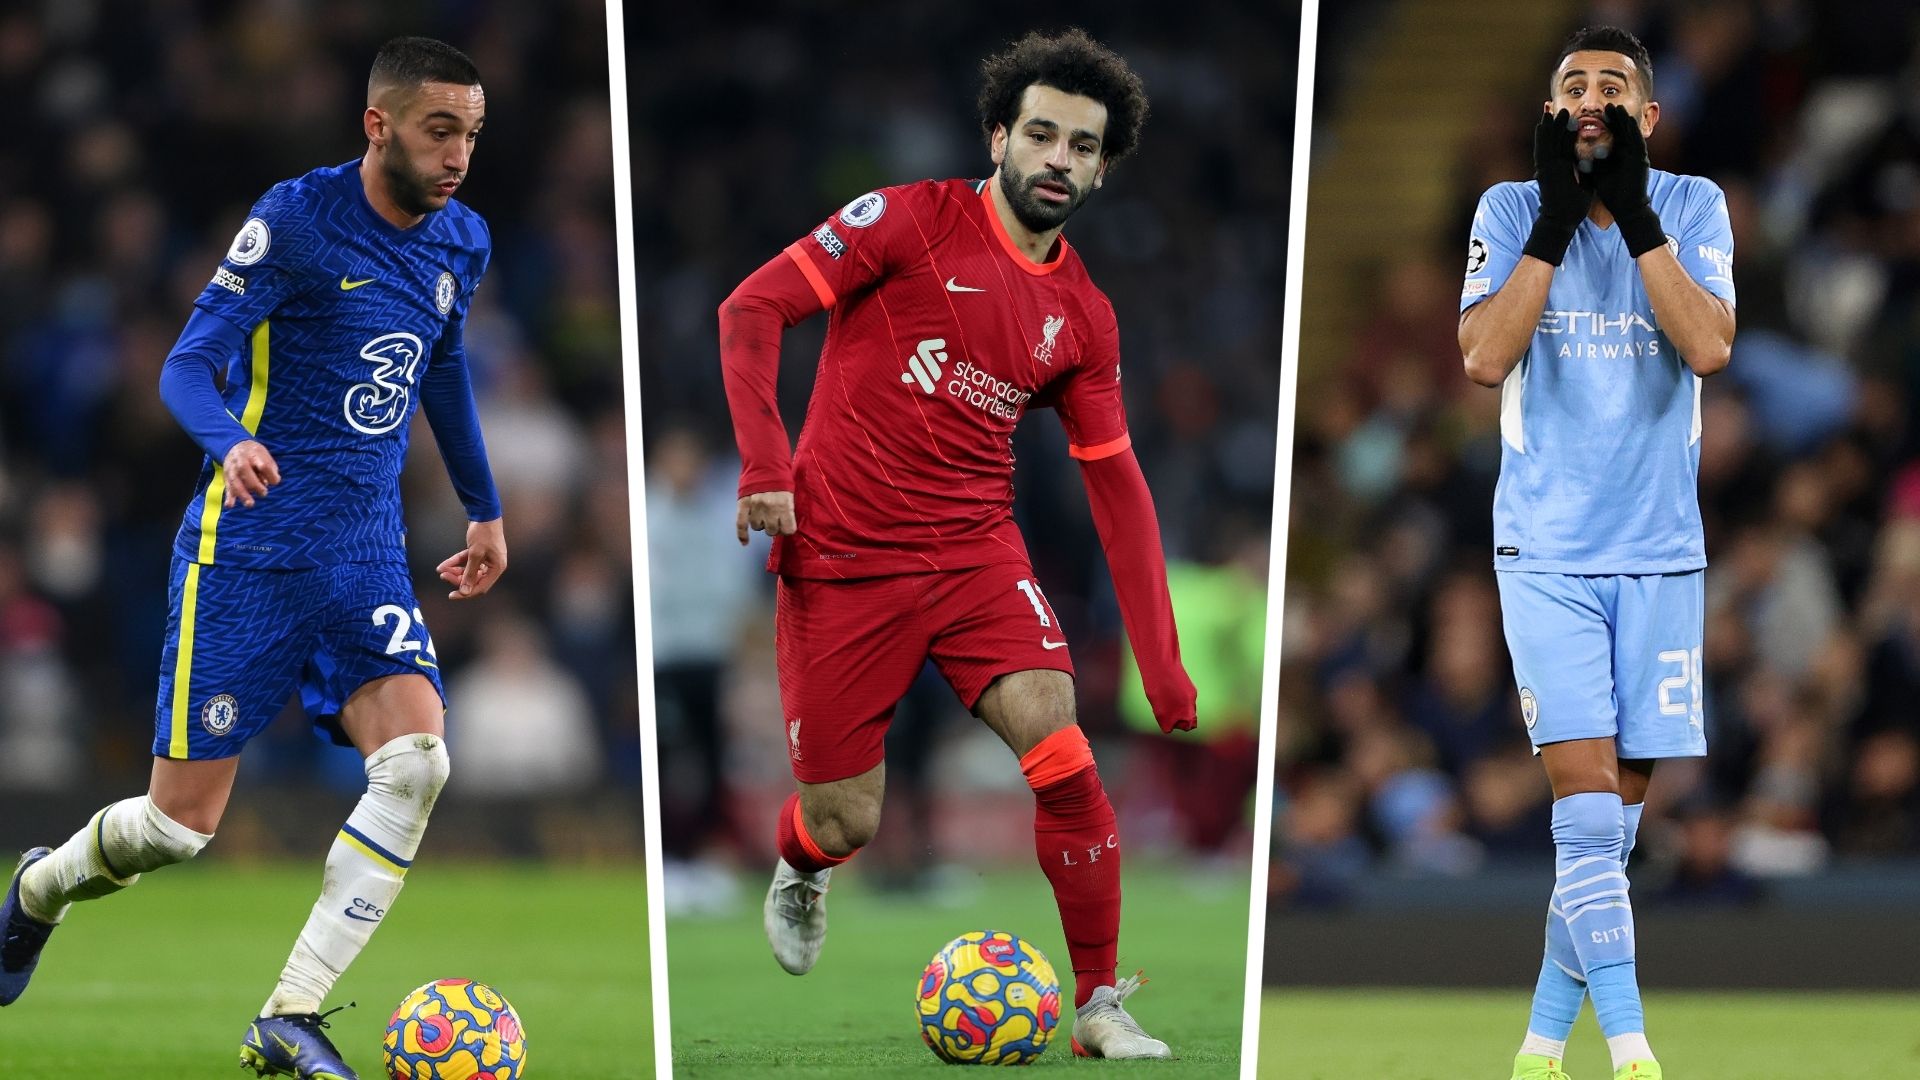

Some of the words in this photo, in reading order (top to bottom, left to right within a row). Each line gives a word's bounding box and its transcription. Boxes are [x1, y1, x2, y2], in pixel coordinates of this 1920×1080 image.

[1536, 311, 1655, 335] ETIHA
[1559, 340, 1658, 359] AIRWAYS
[353, 897, 385, 917] CFC
[1591, 925, 1629, 944] CITY
